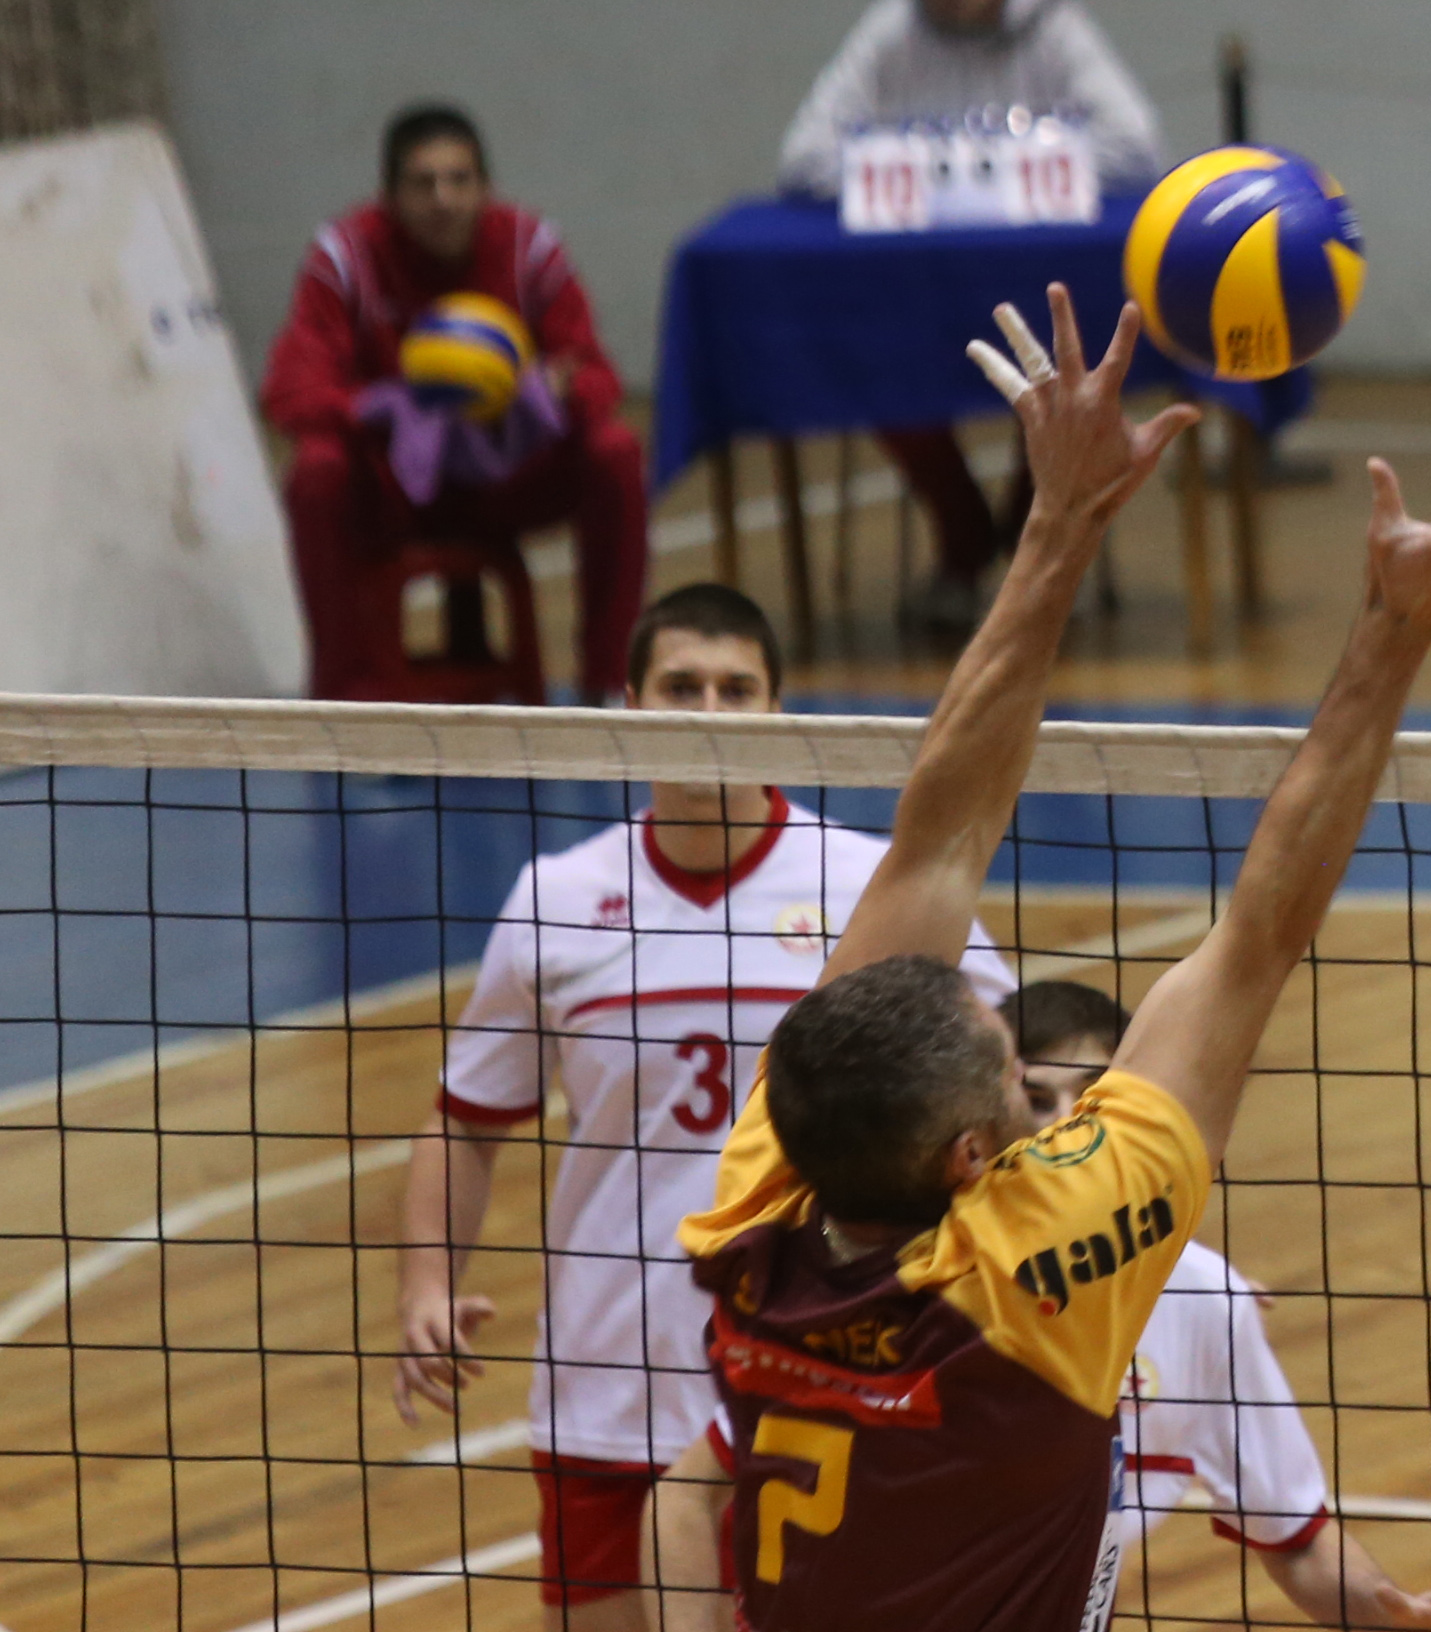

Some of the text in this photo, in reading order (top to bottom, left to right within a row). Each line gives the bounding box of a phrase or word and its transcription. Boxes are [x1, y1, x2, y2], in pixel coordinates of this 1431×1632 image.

[860, 160, 917, 218] 10
[1018, 152, 1074, 212] 10
[671, 1032, 730, 1135] 3
[1014, 1196, 1175, 1316] gala
[752, 1414, 854, 1585] 2
